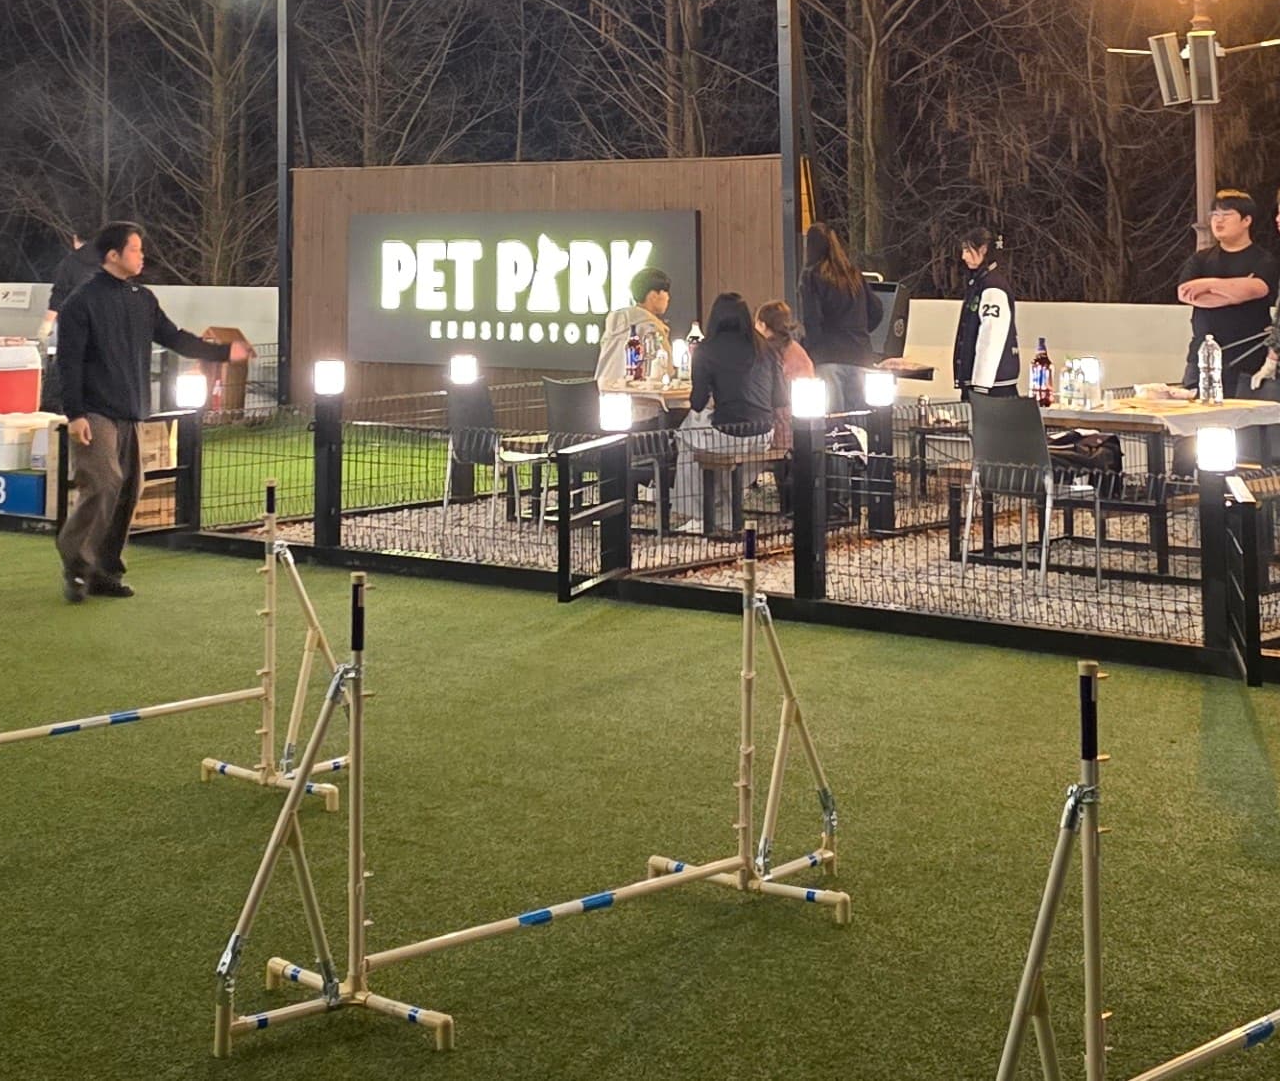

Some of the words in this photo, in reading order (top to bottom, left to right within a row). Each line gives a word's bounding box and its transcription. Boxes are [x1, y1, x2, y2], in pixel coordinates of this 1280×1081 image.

[381, 240, 483, 311] PET
[496, 233, 653, 314] PARK
[982, 304, 1000, 318] 23
